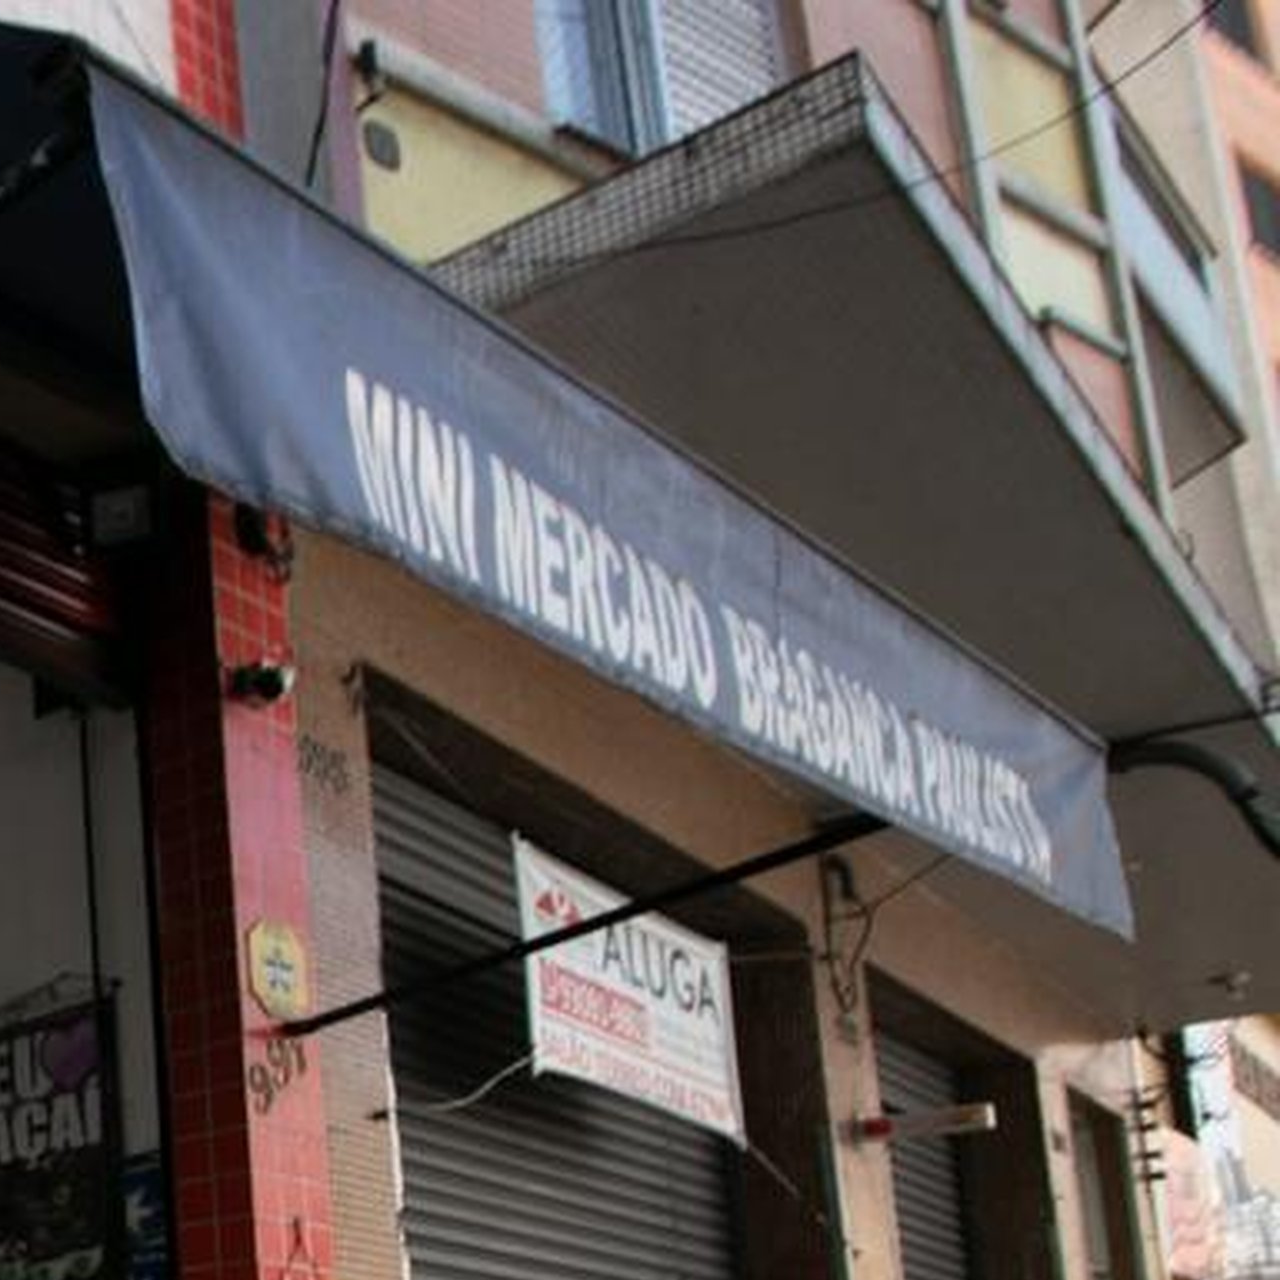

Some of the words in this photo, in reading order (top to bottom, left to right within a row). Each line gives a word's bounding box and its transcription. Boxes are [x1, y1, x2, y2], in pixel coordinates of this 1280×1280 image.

[345, 366, 482, 583] MINI
[489, 452, 718, 710] MERCADO
[602, 922, 721, 1028] ALUGA
